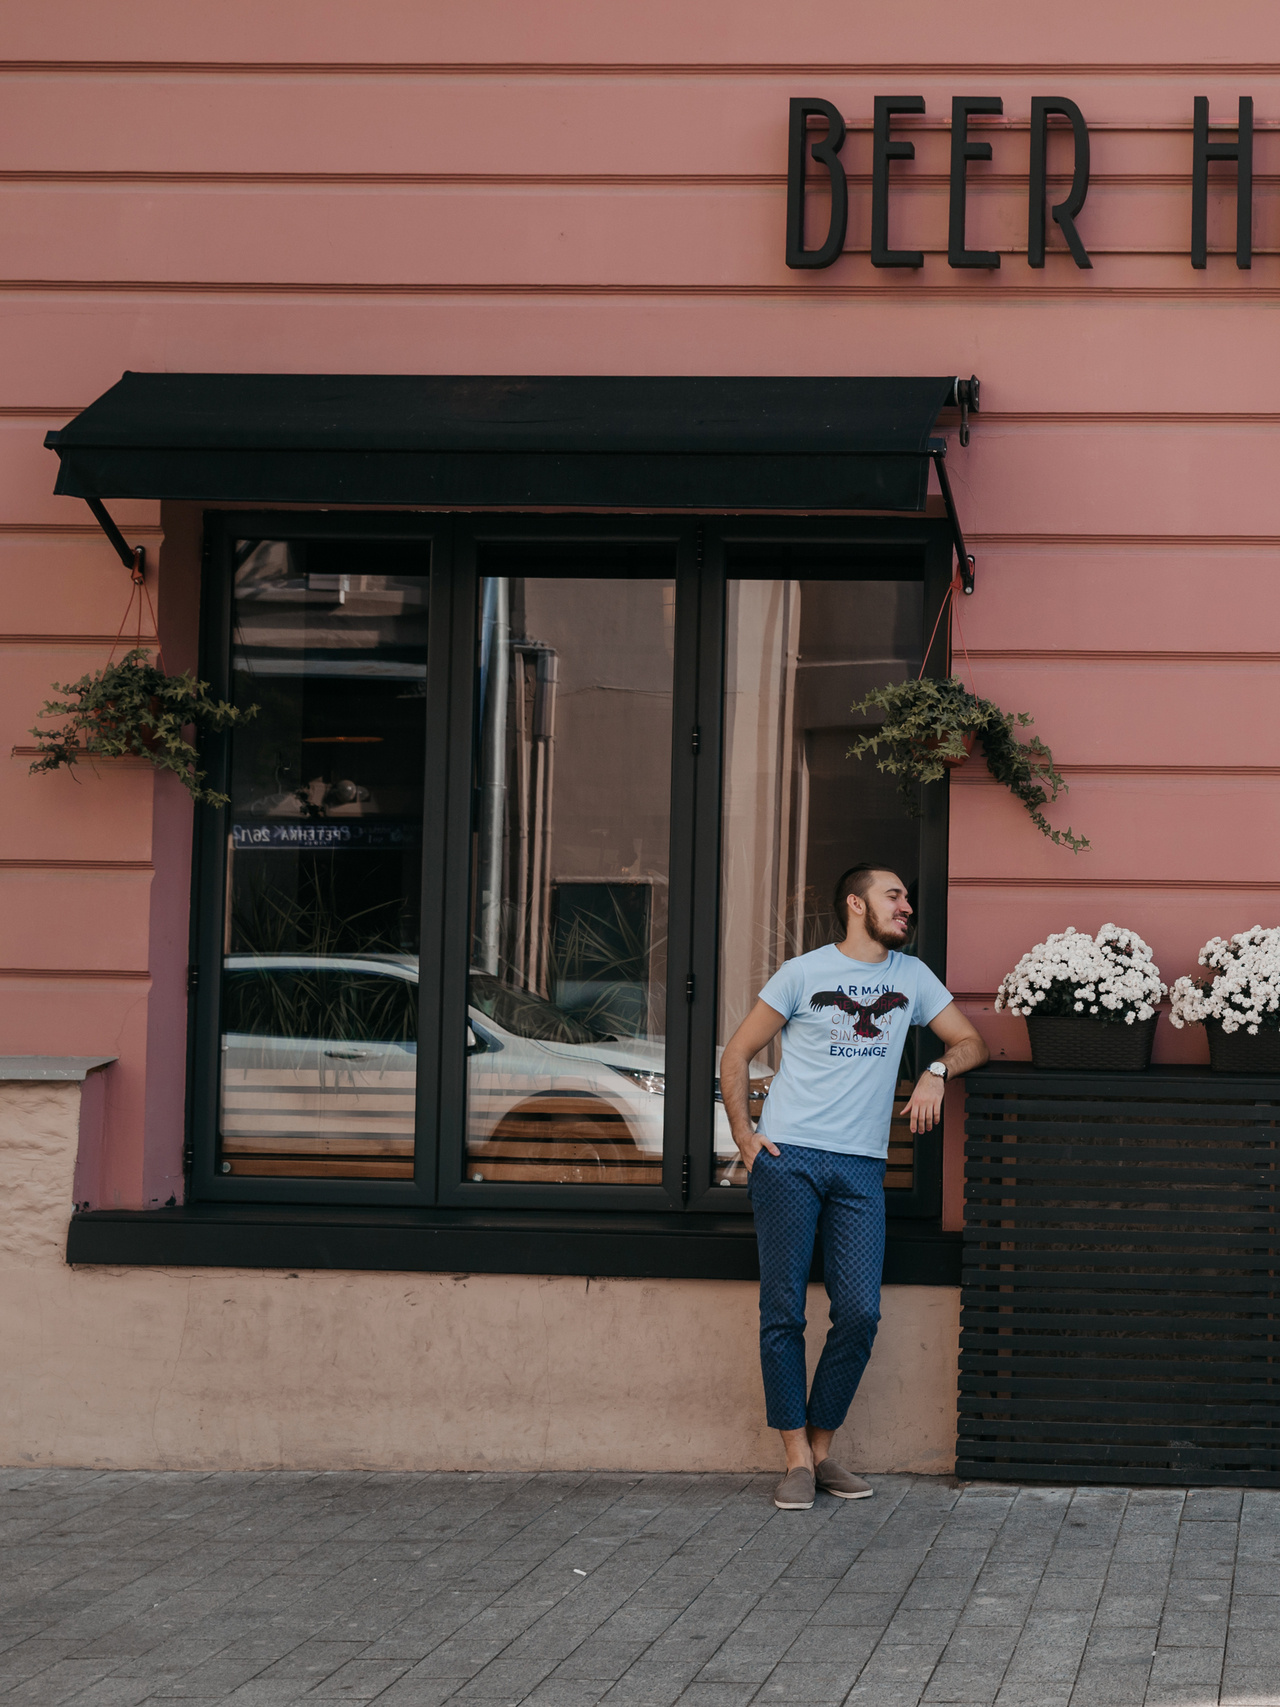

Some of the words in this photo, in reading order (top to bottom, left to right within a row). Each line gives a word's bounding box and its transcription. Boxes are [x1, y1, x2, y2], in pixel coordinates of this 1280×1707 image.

[785, 95, 1093, 270] BEER
[836, 984, 895, 996] ARMANI
[831, 1013, 860, 1026] CITY
[829, 1045, 887, 1058] EXCHANGE
